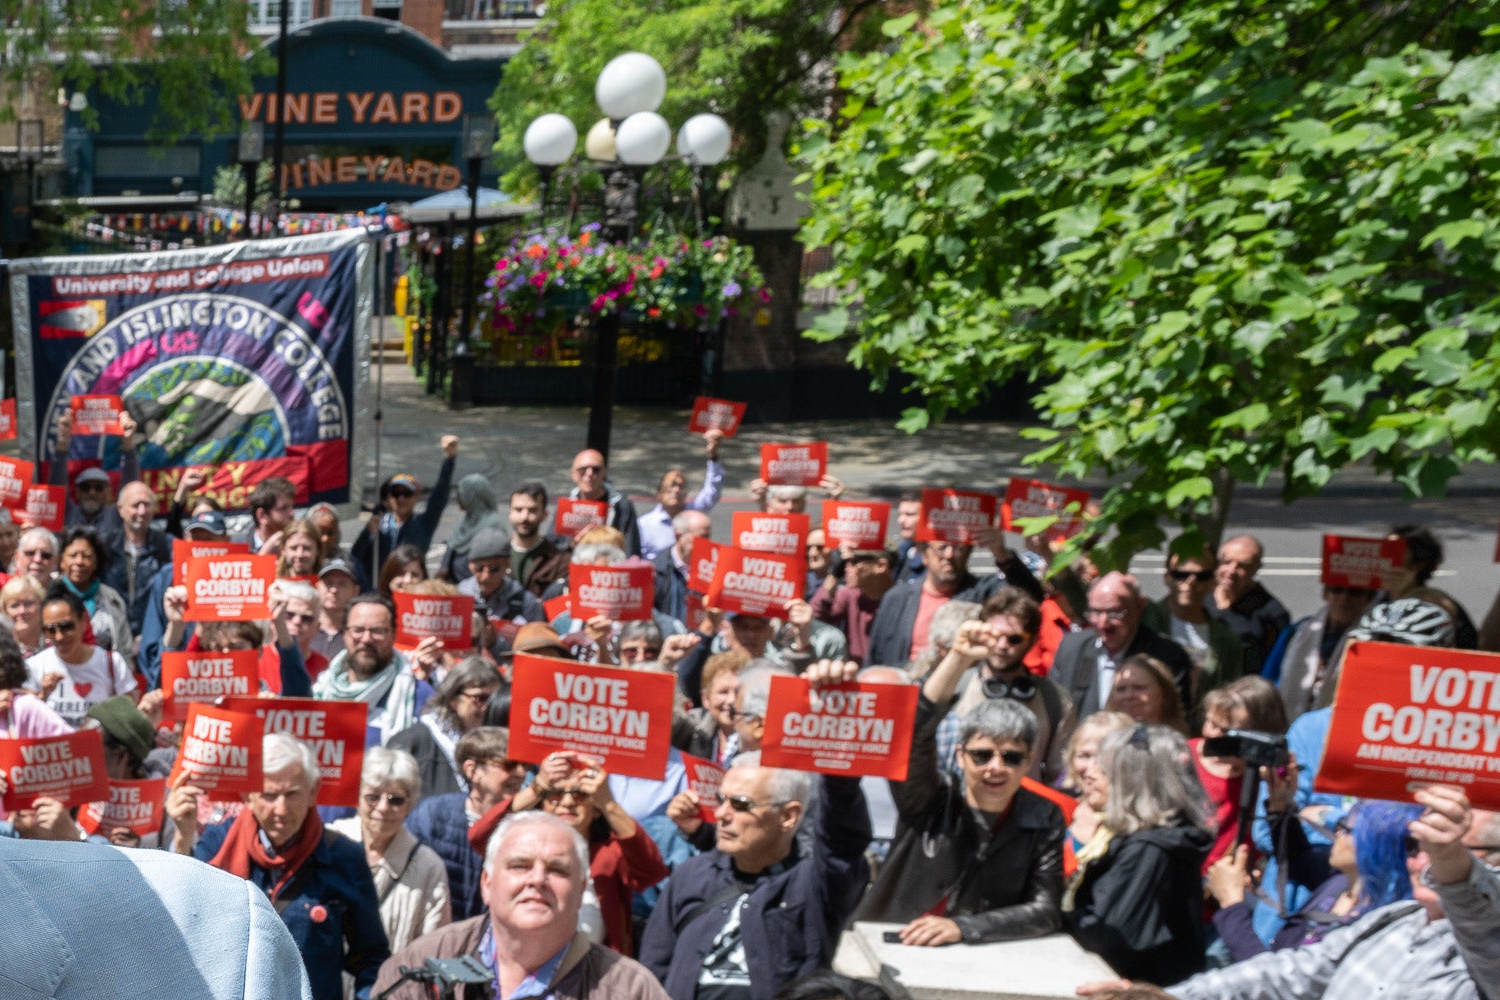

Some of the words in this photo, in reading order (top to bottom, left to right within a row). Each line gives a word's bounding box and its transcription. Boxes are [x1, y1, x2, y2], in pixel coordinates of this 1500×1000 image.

[55, 272, 149, 296] University
[155, 270, 190, 289] and
[266, 256, 323, 277] Union
[72, 336, 118, 394] AND
[120, 300, 273, 345] ISLINGTON
[273, 328, 343, 441] COLLEGE
[778, 448, 810, 460] VOTE
[768, 459, 821, 474] CORBYN
[942, 493, 982, 512] VOTE
[837, 506, 871, 521] VOTE
[928, 508, 990, 526] CORBYN
[751, 518, 790, 533] VOTE
[827, 518, 880, 534] CORBYN
[740, 531, 800, 548] CORBYN
[208, 561, 253, 579] VOTE
[742, 556, 787, 580] VOTE
[195, 578, 265, 598] CORBYN
[589, 570, 630, 587] VOTE
[723, 571, 796, 599] CORBYN
[578, 584, 643, 603] CORBYN
[412, 599, 453, 615] VOTE
[401, 612, 464, 632] CORBYN
[187, 658, 235, 678] VOTE
[173, 677, 249, 696] CORBYN
[554, 671, 629, 708] VOTE
[808, 688, 878, 717] VOTE
[528, 696, 650, 738] CORBYN
[782, 711, 895, 743] CORBYN
[1361, 702, 1500, 753] CORBY
[20, 741, 73, 765] VOTE
[1381, 744, 1485, 771] INDEPENDENT
[10, 756, 92, 786] CORBYN
